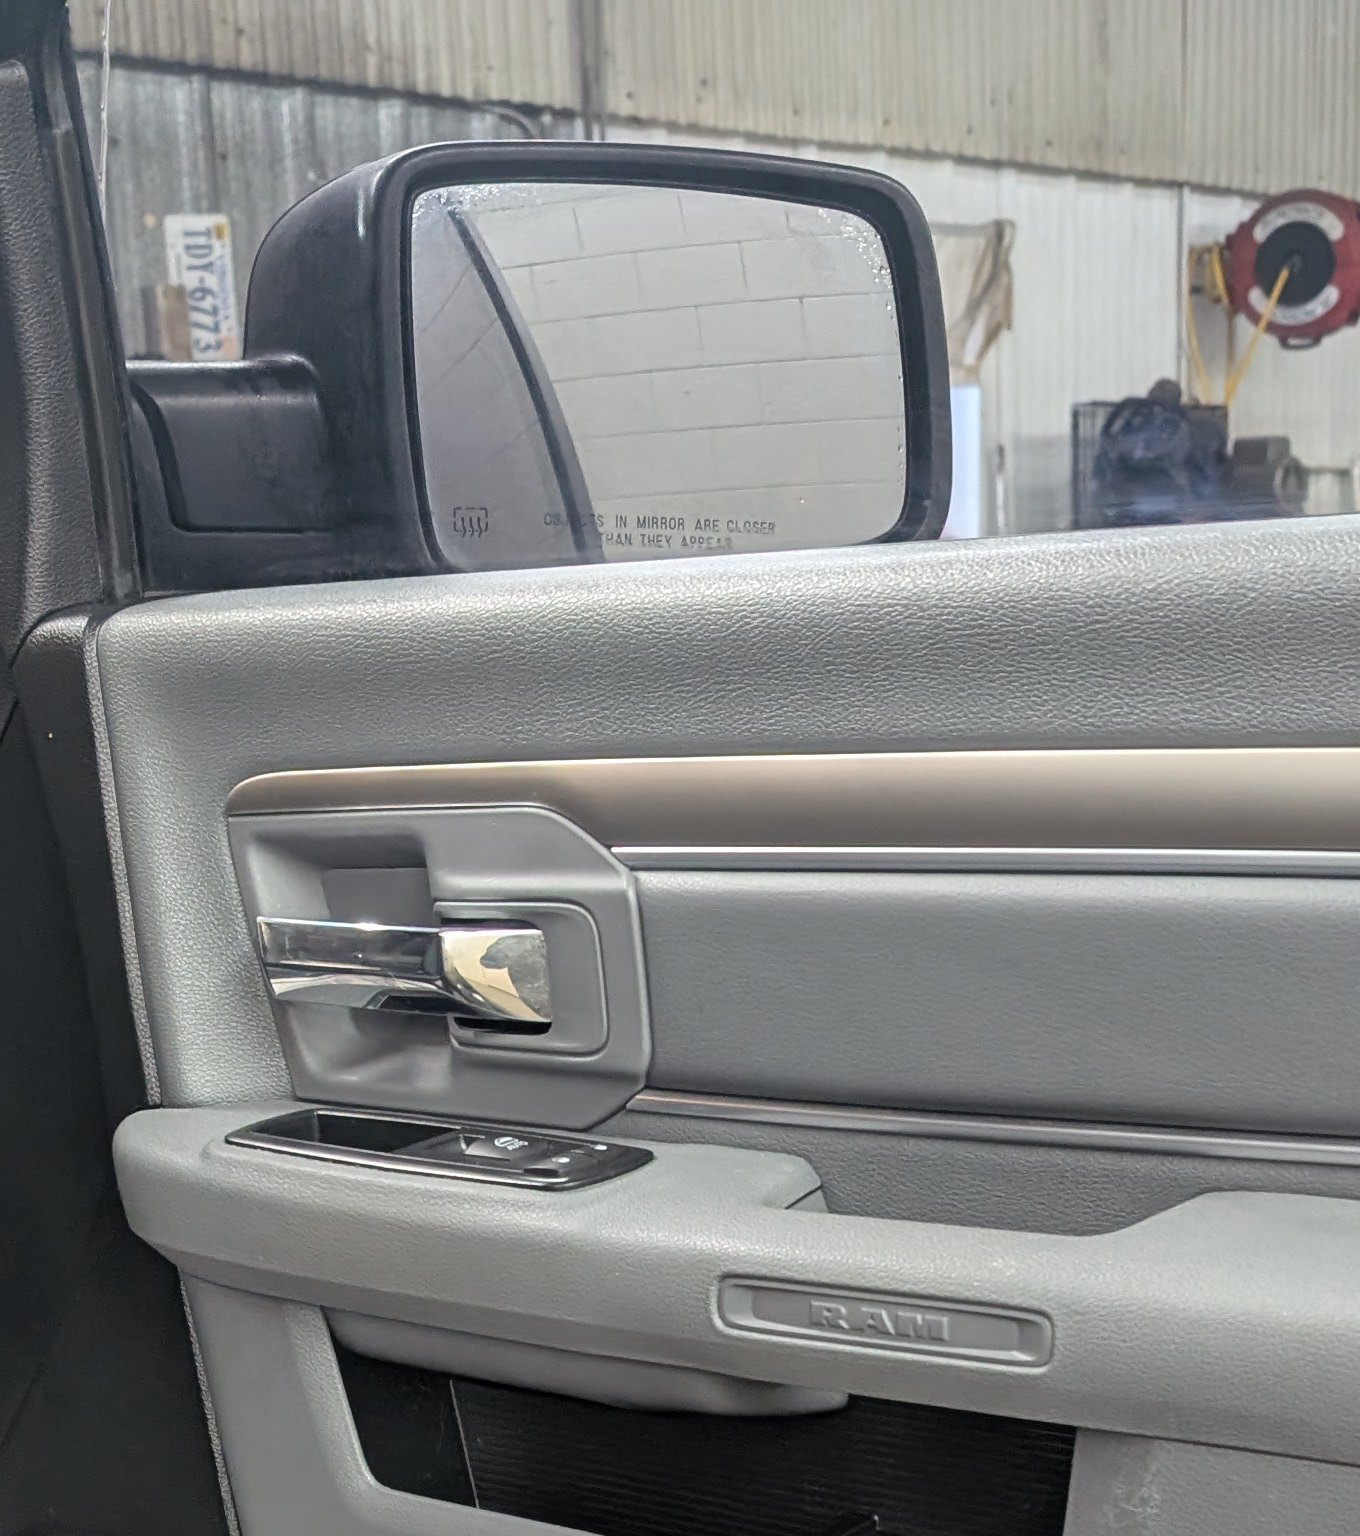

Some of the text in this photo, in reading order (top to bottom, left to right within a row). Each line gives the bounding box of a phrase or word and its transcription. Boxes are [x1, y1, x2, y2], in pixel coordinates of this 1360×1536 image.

[543, 512, 776, 534] OBTS IN MIRROR ARE CLOSER
[639, 533, 672, 548] THEY
[809, 1300, 950, 1342] RAM
